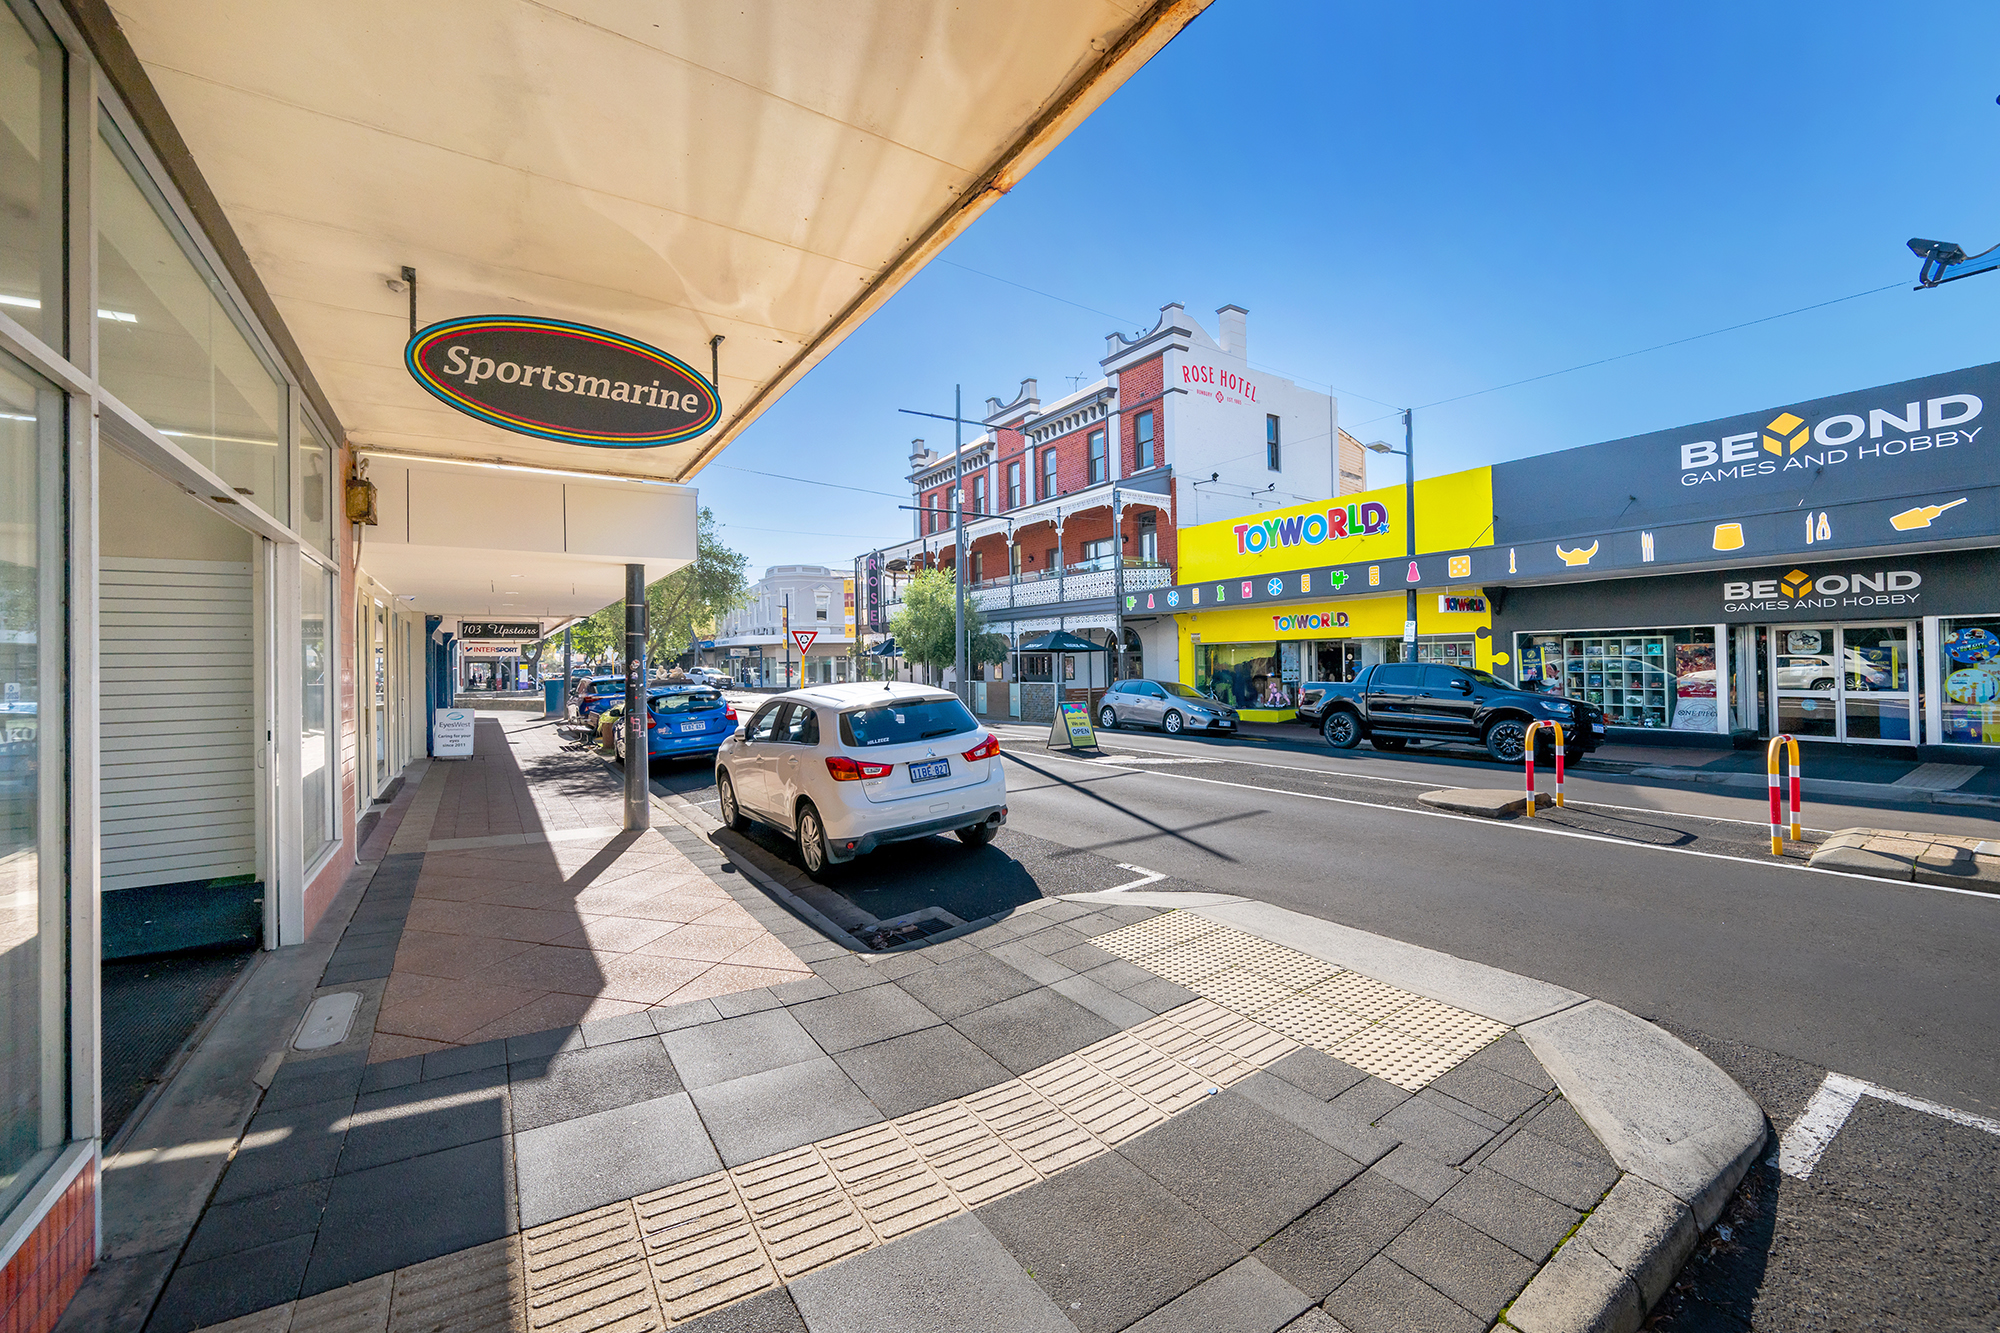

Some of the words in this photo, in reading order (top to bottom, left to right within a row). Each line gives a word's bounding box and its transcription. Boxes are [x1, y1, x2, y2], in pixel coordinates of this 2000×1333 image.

[443, 345, 699, 414] Sportsmarine
[1182, 365, 1215, 384] ROSE
[1220, 369, 1256, 402] HOTEL
[1681, 394, 1984, 470] BEYOND
[1681, 461, 1776, 486] GAMES
[1783, 449, 1849, 472] AND
[1858, 426, 1982, 460] HOBBY
[1234, 502, 1389, 554] TOYWORLD
[869, 558, 878, 621] ROSE
[1724, 569, 1922, 600] BEYOND
[1724, 600, 1790, 613] GAMES
[1794, 597, 1837, 609] AND
[1843, 593, 1920, 607] HOBBY
[1273, 612, 1350, 631] TOYWORLD
[1445, 597, 1485, 611] TOYWORLD
[464, 625, 482, 634] 103
[488, 623, 538, 637] Upstairs
